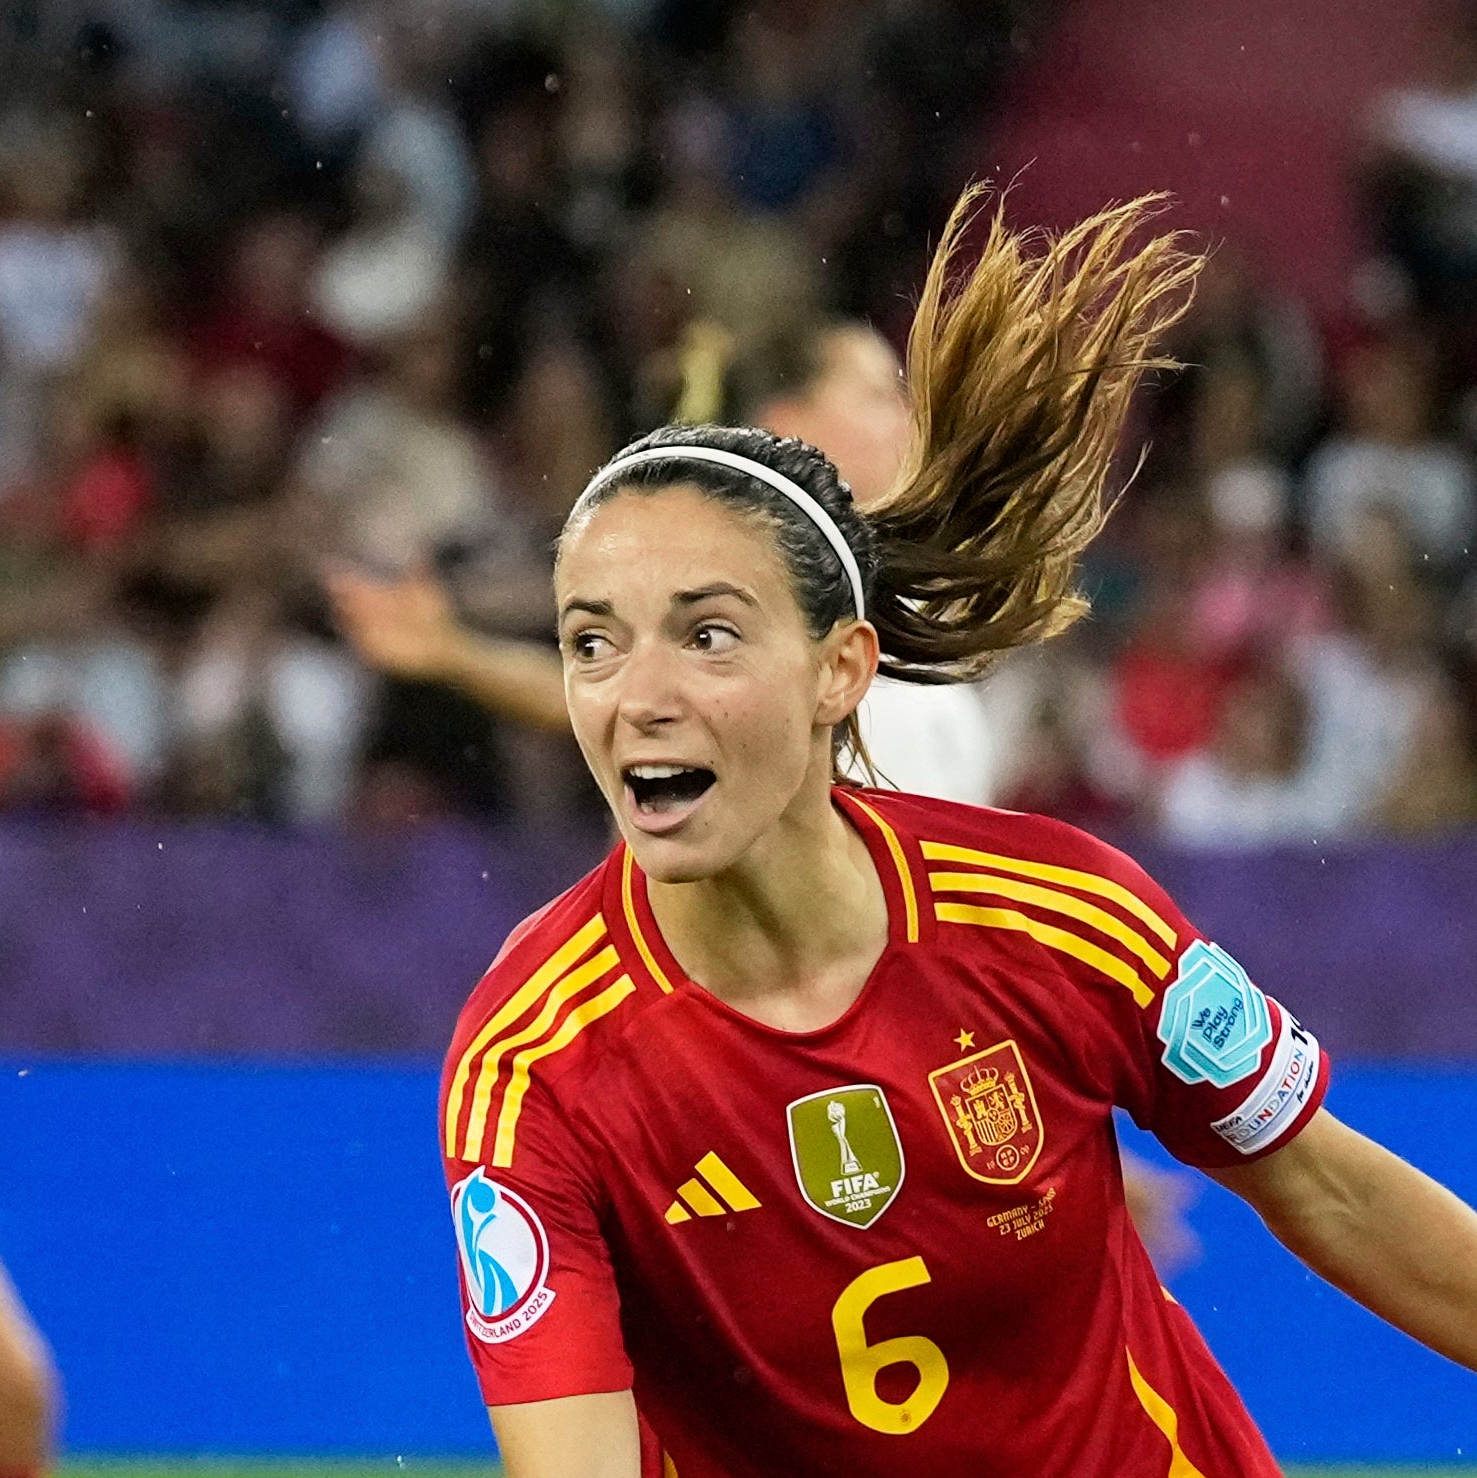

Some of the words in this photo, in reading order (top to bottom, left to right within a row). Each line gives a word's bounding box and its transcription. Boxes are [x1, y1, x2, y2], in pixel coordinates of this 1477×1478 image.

[1192, 1007, 1211, 1030] We
[1202, 1006, 1228, 1043] Play
[1212, 997, 1244, 1050] Strong
[1213, 1116, 1243, 1132] UEFA
[830, 1172, 880, 1198] FIFA
[845, 1198, 872, 1213] 2023
[986, 1205, 1029, 1228] GERMANY
[999, 1224, 1011, 1236] 23
[1012, 1213, 1031, 1229] JULY
[522, 1291, 548, 1321] 2025
[832, 1255, 949, 1436] 6
